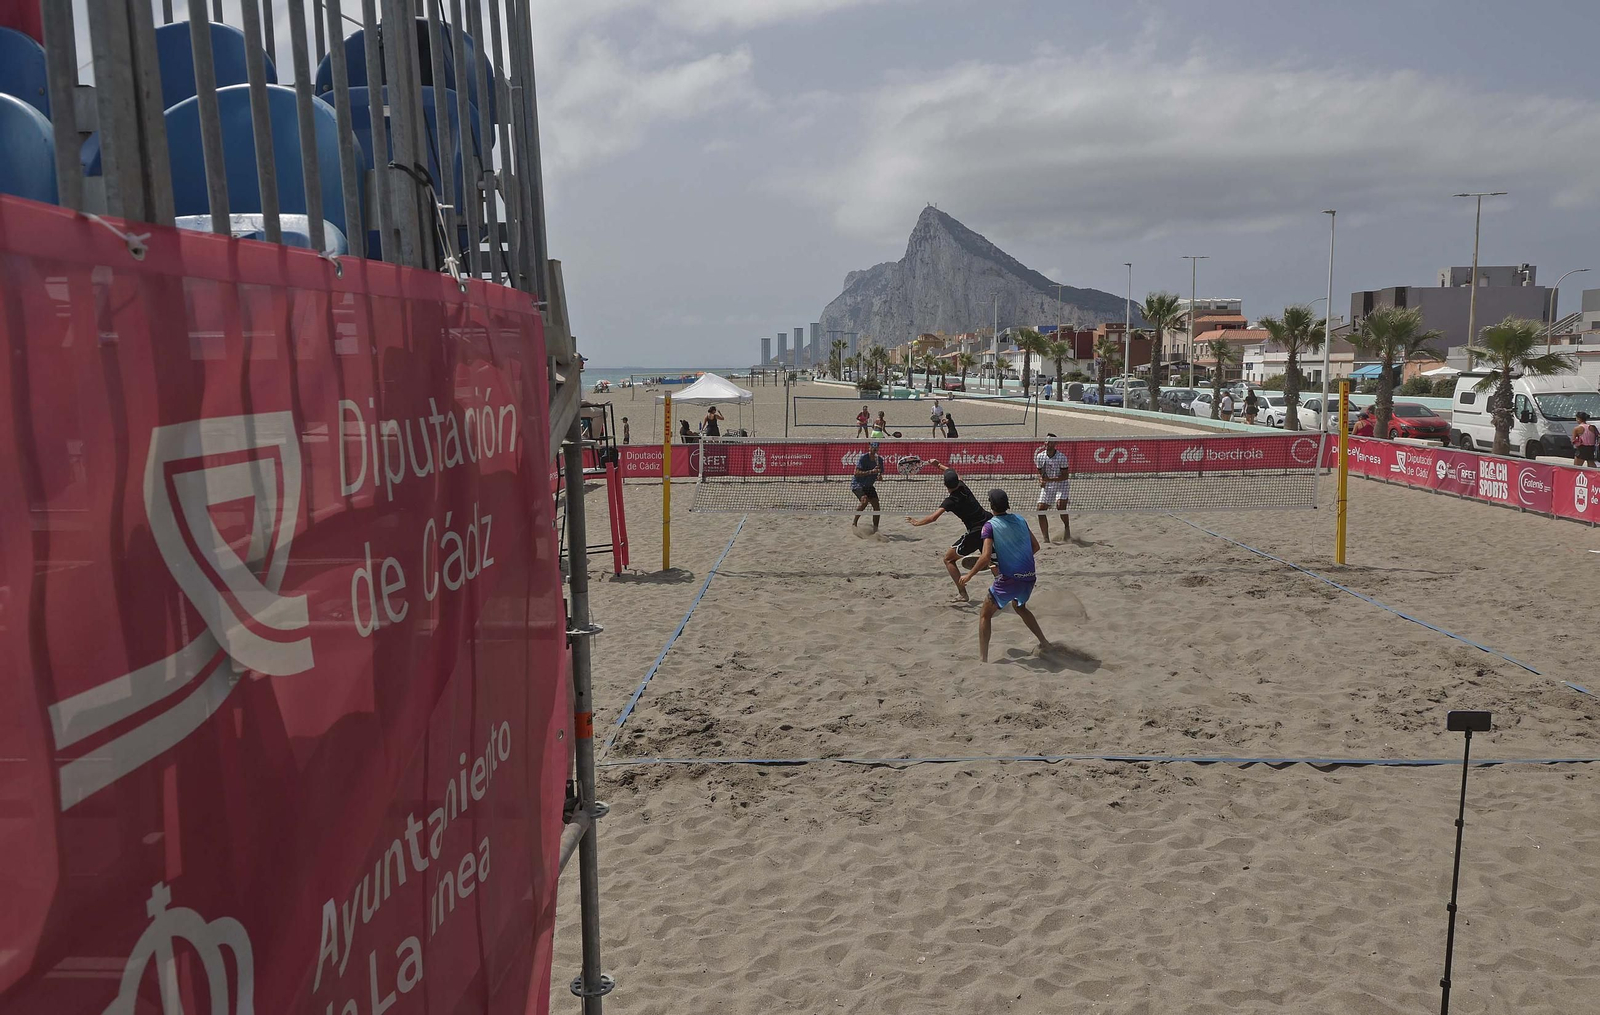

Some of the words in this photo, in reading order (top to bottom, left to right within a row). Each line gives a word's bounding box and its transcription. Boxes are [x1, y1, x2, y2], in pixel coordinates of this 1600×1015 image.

[338, 386, 517, 501] Diputación
[627, 462, 637, 470] de
[639, 461, 660, 470] Cádiz
[1406, 466, 1414, 476] de
[1480, 461, 1507, 481] BEACH
[1461, 469, 1476, 479] RFET
[1480, 479, 1508, 499] SPORTS
[1590, 496, 1599, 504] de
[351, 541, 409, 638] de
[423, 501, 494, 601] Cádz
